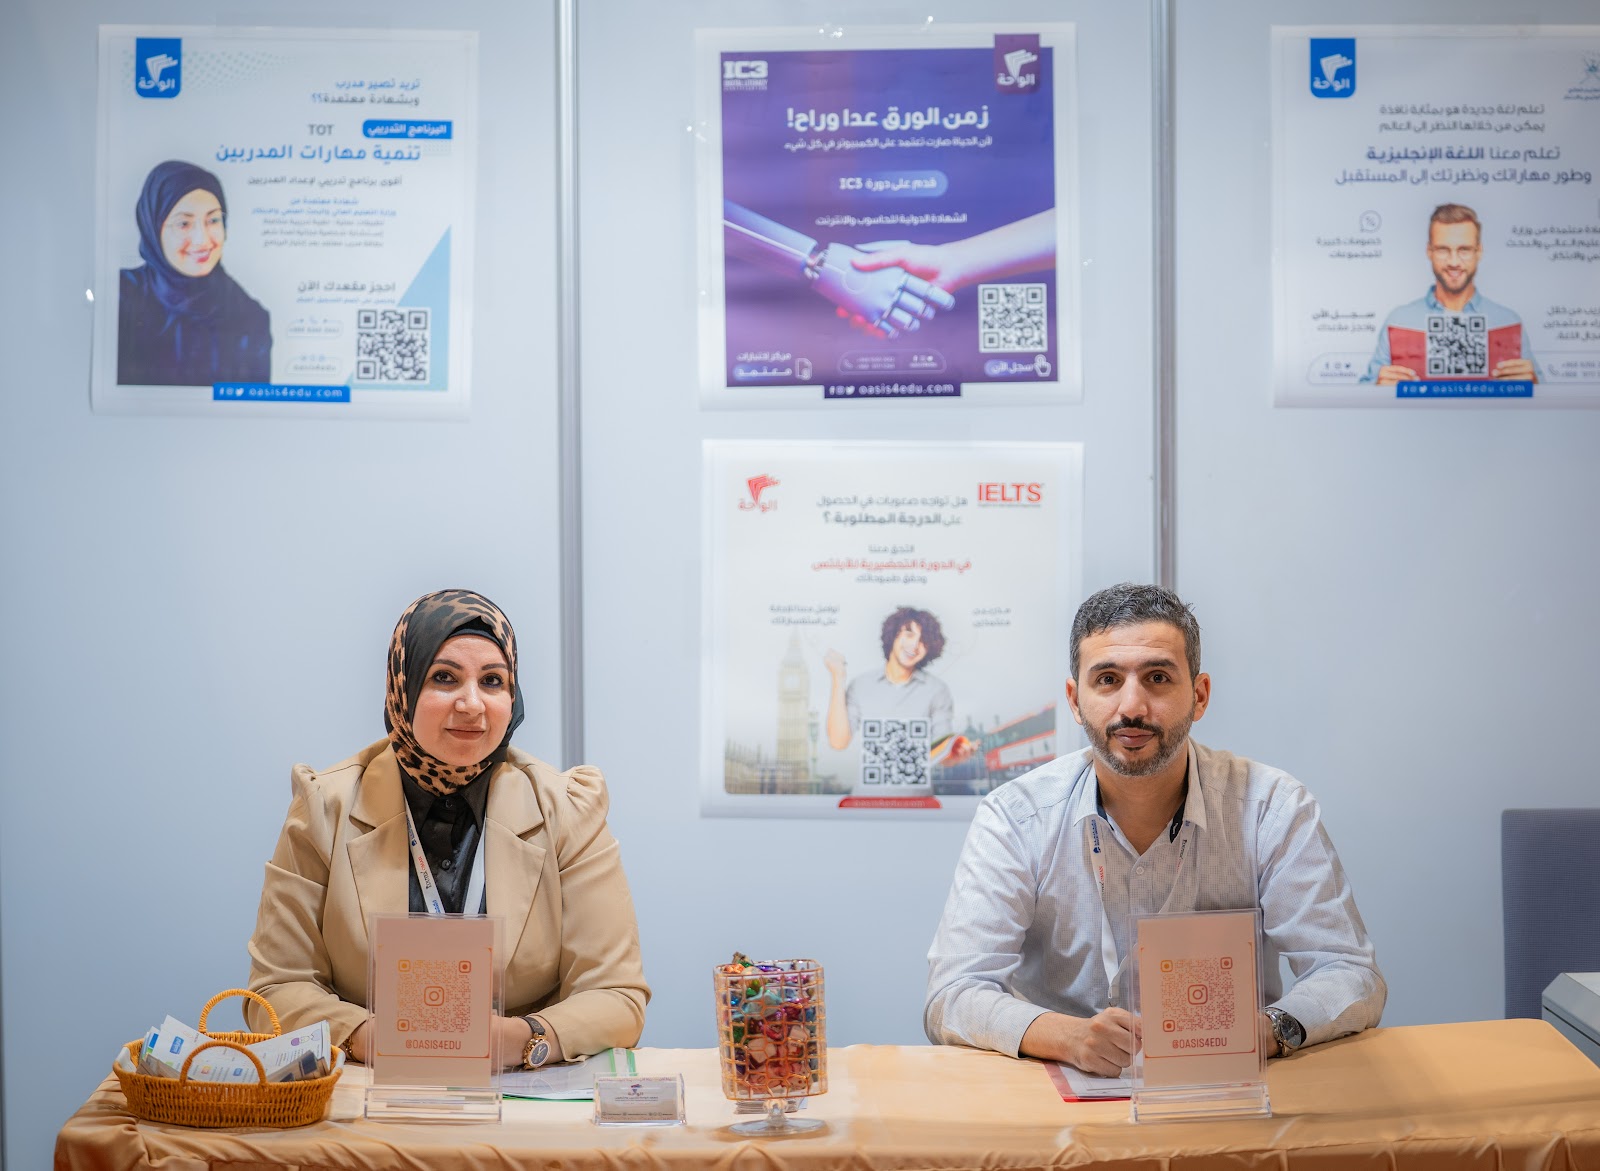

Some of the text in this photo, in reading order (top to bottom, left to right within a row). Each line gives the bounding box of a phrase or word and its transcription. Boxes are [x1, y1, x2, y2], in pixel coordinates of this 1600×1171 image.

[723, 61, 768, 79] IC3
[335, 80, 365, 90] مدرب
[399, 79, 420, 90] تريد
[370, 93, 420, 106] وبشهادة
[1380, 103, 1545, 116] تعلم لغة جديدة هو بمثابة نافذة
[787, 105, 989, 132] زمن الورق عدا وراح!
[308, 124, 334, 135] TOT
[367, 123, 446, 137] البرنامج التدريبي
[1379, 121, 1411, 133] العالم
[1430, 121, 1457, 133] النظر
[1459, 121, 1492, 131] خلالها
[1494, 121, 1511, 133] من
[1513, 121, 1545, 133] يمكن
[835, 138, 878, 150] الكمبيوتر
[878, 138, 896, 149] على
[897, 137, 925, 147] تعتمد
[953, 136, 977, 148] الحياة
[216, 144, 421, 165] تنمية مهارات المدربين
[1367, 146, 1561, 165] تعلم معنا اللغة الإنجليزية
[248, 175, 287, 186] المدربين
[350, 176, 377, 188] برنامج
[1335, 168, 1408, 186] المستقبل
[1431, 168, 1489, 185] ونظرتك
[1492, 168, 1550, 185] مهاراتك
[1553, 169, 1592, 185] وطور
[839, 177, 937, 191] قدم على دورة IC3
[900, 213, 930, 225] الدولية
[931, 212, 967, 223] الشهادة
[324, 281, 366, 292] مقعدك
[369, 282, 396, 294] احجز
[859, 383, 954, 395] oasis4edu.com
[978, 483, 1042, 502] IELTS
[835, 511, 896, 527] المطلوبة
[899, 513, 941, 527] الدرجة
[405, 1039, 461, 1050] @OASIS4EDU
[1172, 1037, 1227, 1049] @OASIS4EDU
